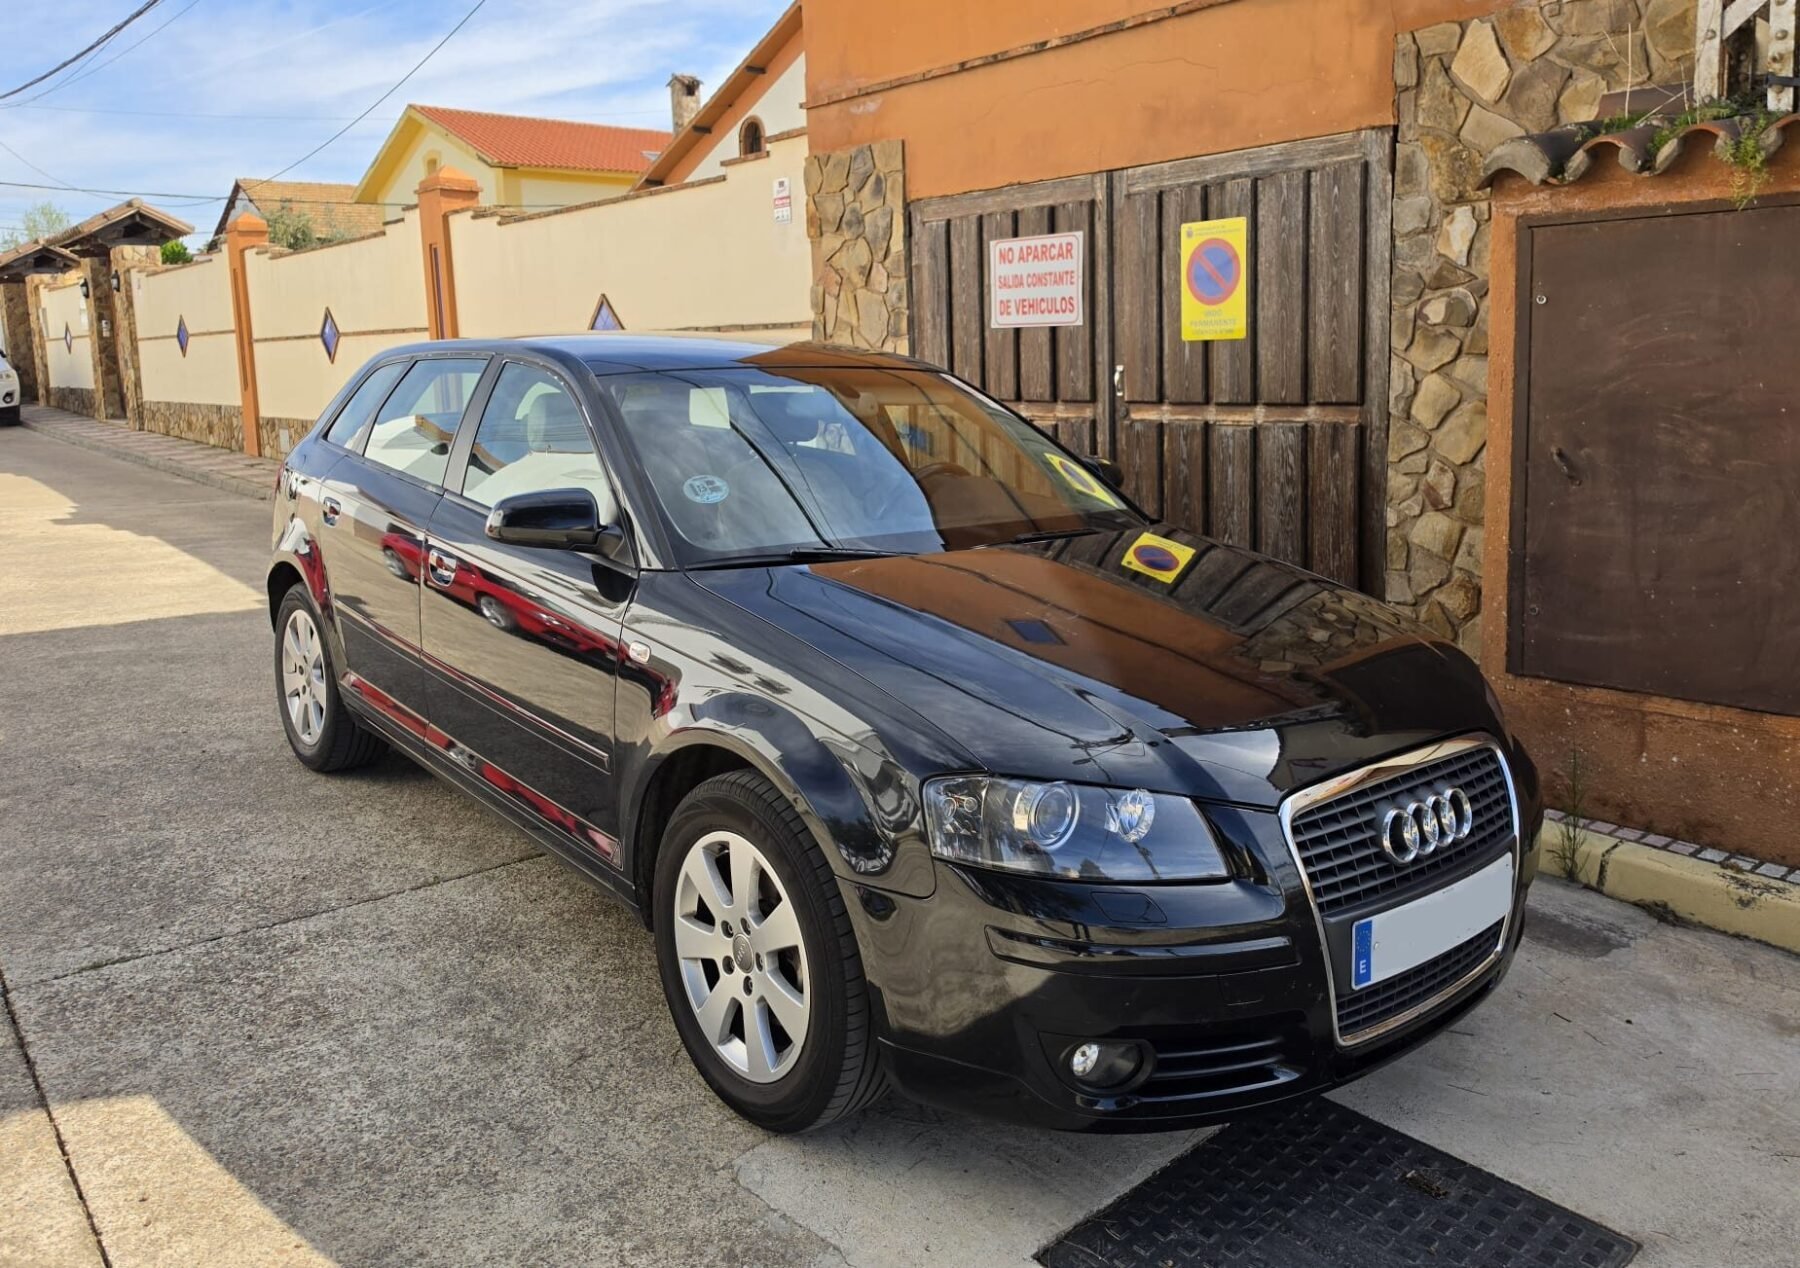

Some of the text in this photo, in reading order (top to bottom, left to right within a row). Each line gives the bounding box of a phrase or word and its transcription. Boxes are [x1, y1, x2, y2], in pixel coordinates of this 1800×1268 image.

[999, 242, 1073, 264] NO APARCAR
[998, 270, 1075, 289] SALIDA CONSTANTE
[1000, 296, 1075, 316] DE VEHICULOS
[1359, 959, 1367, 975] E
